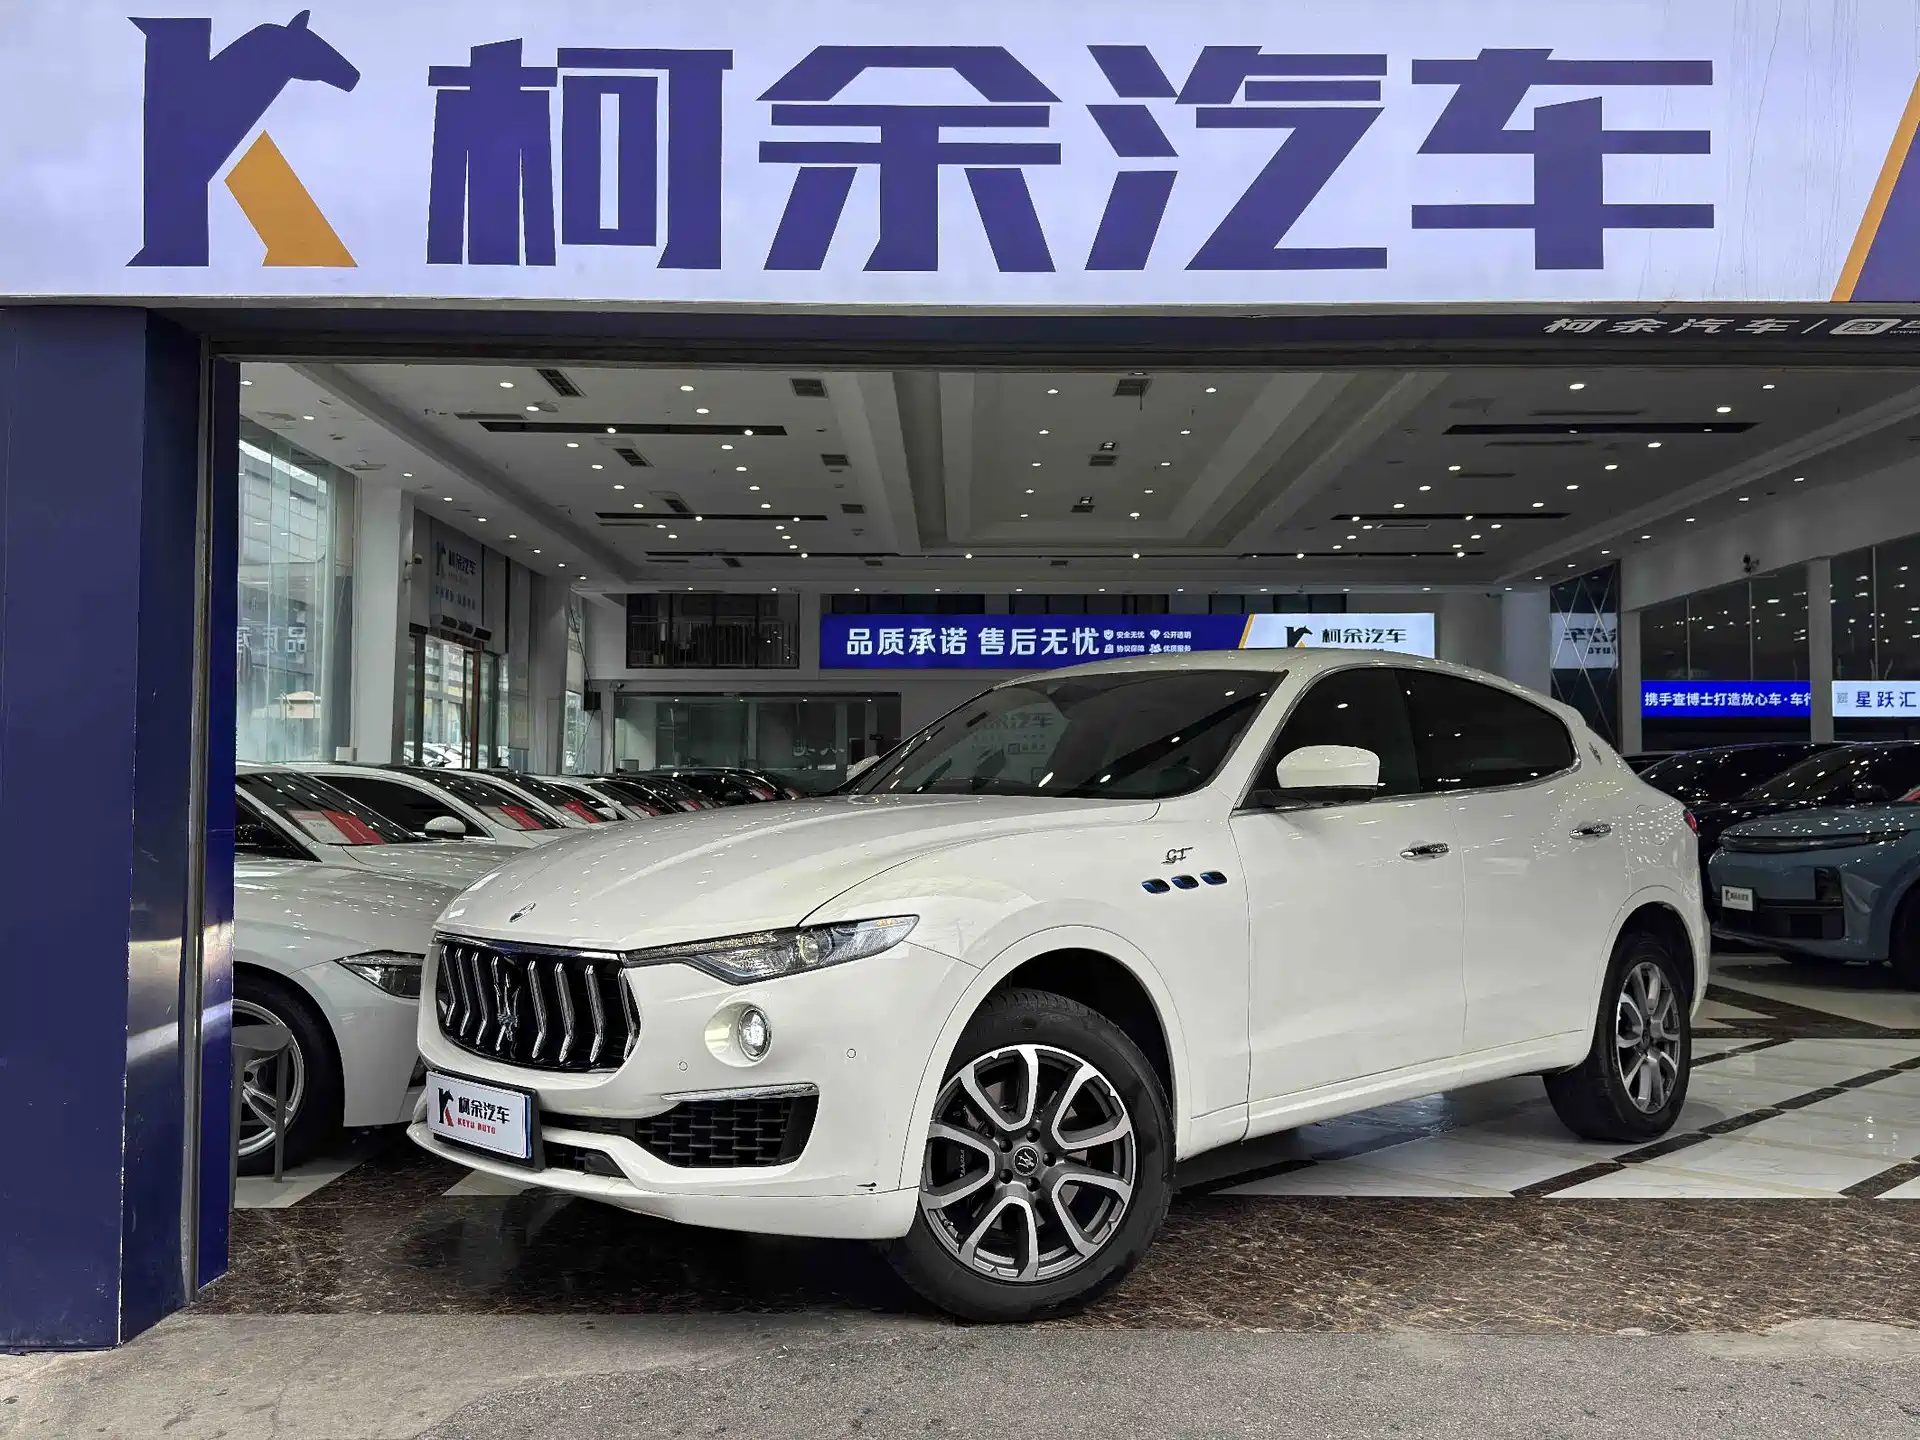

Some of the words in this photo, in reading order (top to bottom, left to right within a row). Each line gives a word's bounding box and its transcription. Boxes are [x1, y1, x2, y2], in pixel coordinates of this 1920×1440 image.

[428, 37, 1714, 272] 柯余汽车
[1543, 317, 1801, 334] 柯余汽车
[846, 626, 968, 656] 品质承诺
[978, 626, 1100, 656] 售后无忧
[1116, 630, 1145, 640] 安全无忧
[1321, 628, 1407, 644] 柯余汽车
[1855, 690, 1918, 709] 星跃汇
[1160, 846, 1195, 865] GT
[458, 1095, 510, 1125] 柯余汽车
[457, 1116, 476, 1129] KEYU
[477, 1122, 497, 1135] AUTO
